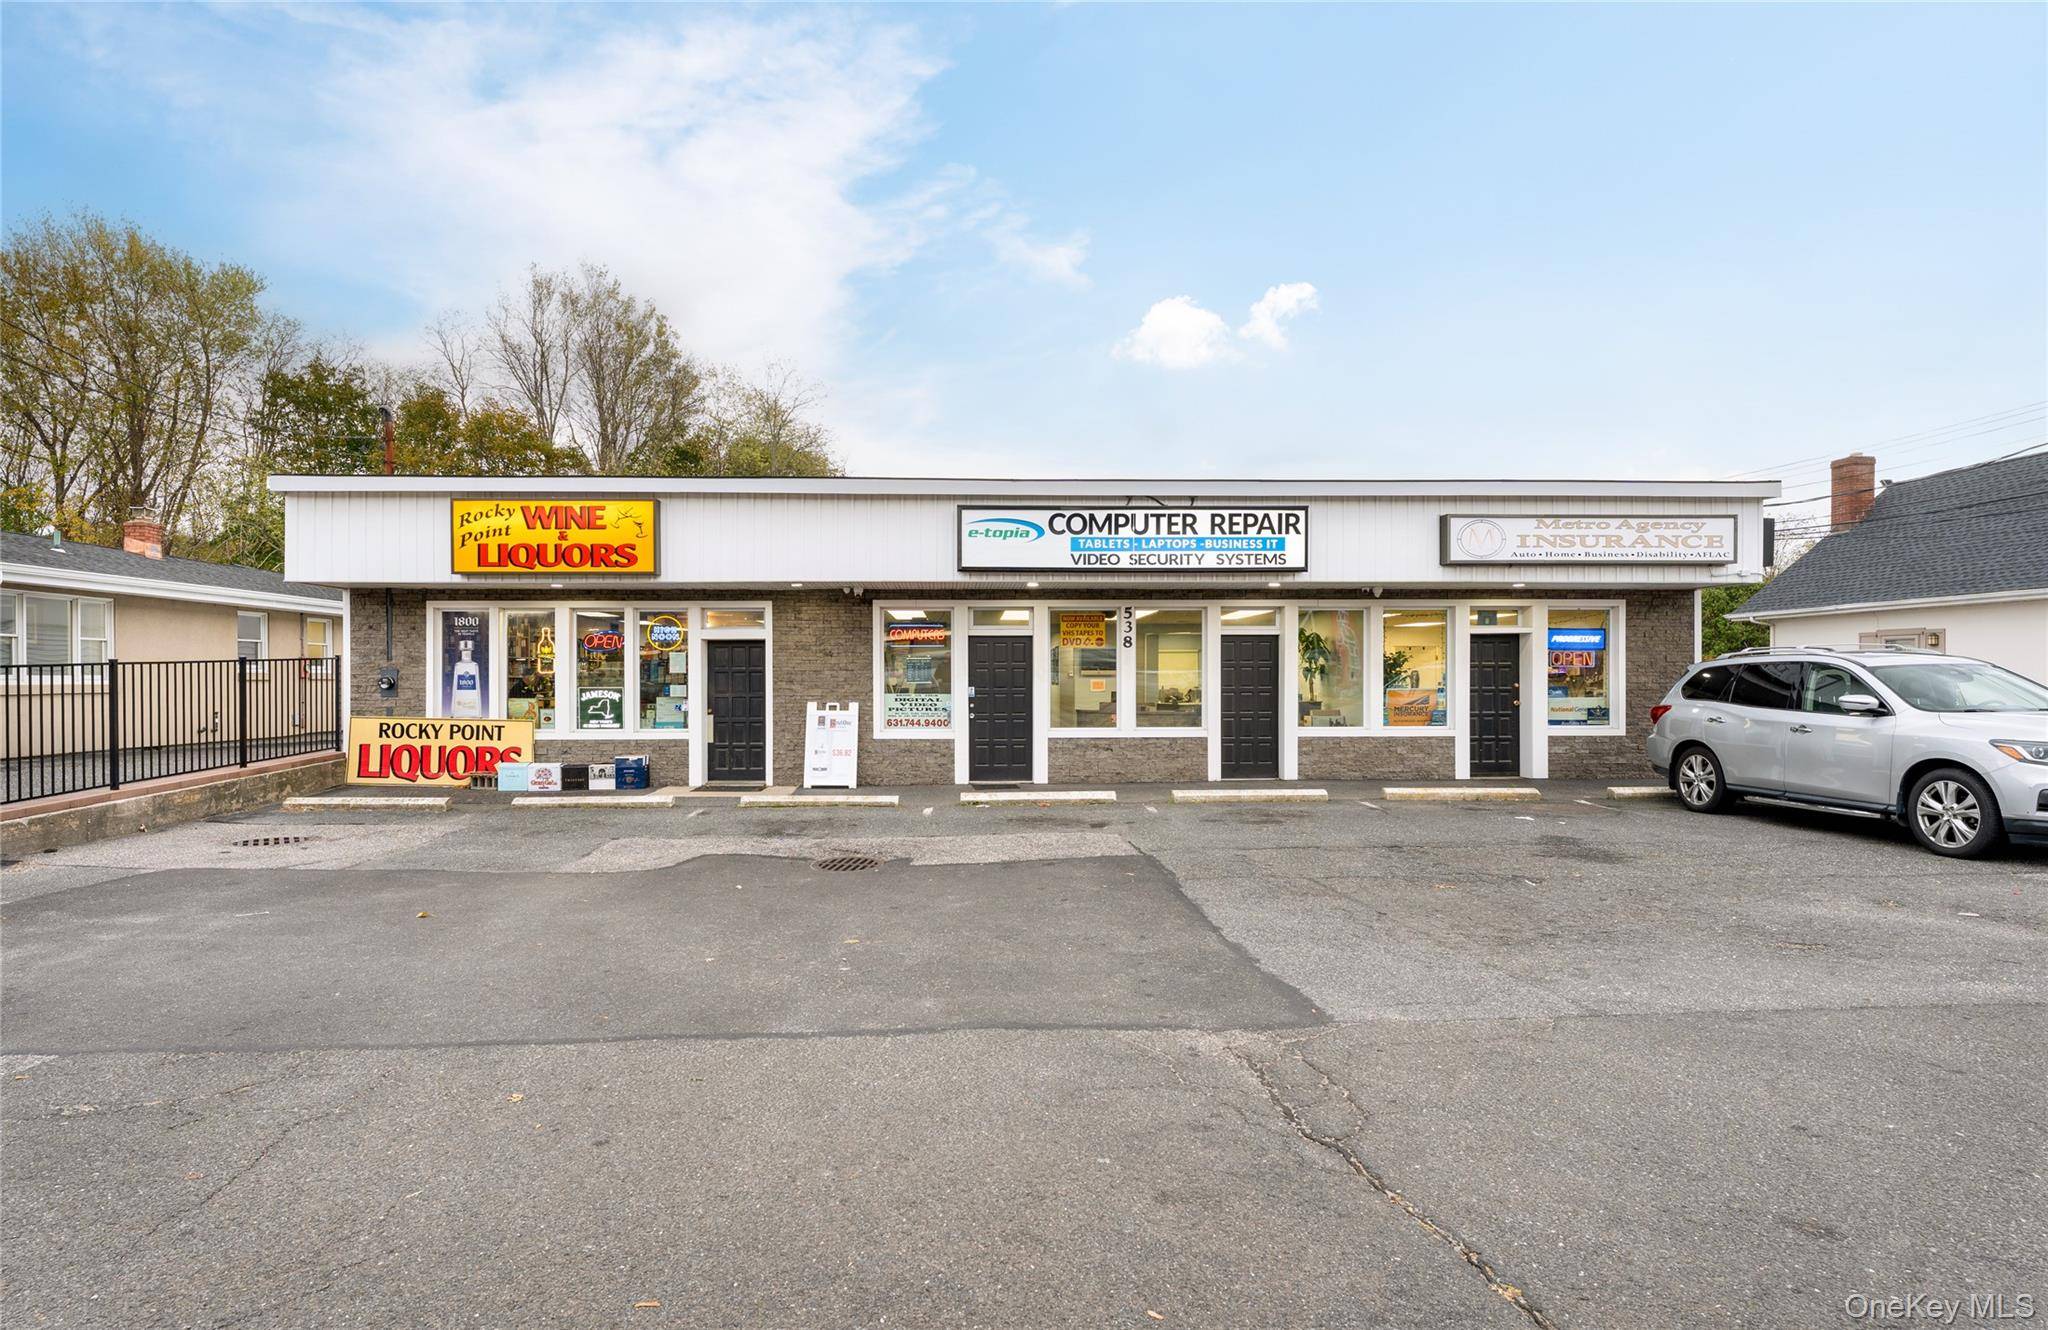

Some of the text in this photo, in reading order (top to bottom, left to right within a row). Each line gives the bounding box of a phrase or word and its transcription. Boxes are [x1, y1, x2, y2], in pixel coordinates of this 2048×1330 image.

[459, 503, 516, 529] Rocky
[521, 505, 607, 530] WINE
[1048, 513, 1301, 535] COMPUTER REPAIR
[1534, 518, 1707, 533] Metro Agency
[459, 524, 512, 549] Point
[557, 531, 569, 541] &
[968, 526, 1030, 541] e-topia
[1078, 538, 1130, 549] TABLETS
[1142, 538, 1197, 549] LAPTOPS
[1266, 538, 1278, 549] IT
[1516, 534, 1725, 548] INSURANCE
[477, 543, 638, 570] LIQUORS
[1071, 553, 1287, 565] VIDEO SECURITY SYSTEMS
[1636, 551, 1689, 559] Disability
[454, 617, 479, 627] 1800
[585, 634, 624, 648] OPEN
[890, 629, 945, 640] COMPUTERS
[1062, 637, 1082, 646] DVD
[1552, 651, 1592, 666] OPEN
[581, 690, 621, 702] JAMESON
[887, 718, 950, 727] 631.744.9400
[378, 722, 506, 741] ROCKY POINT
